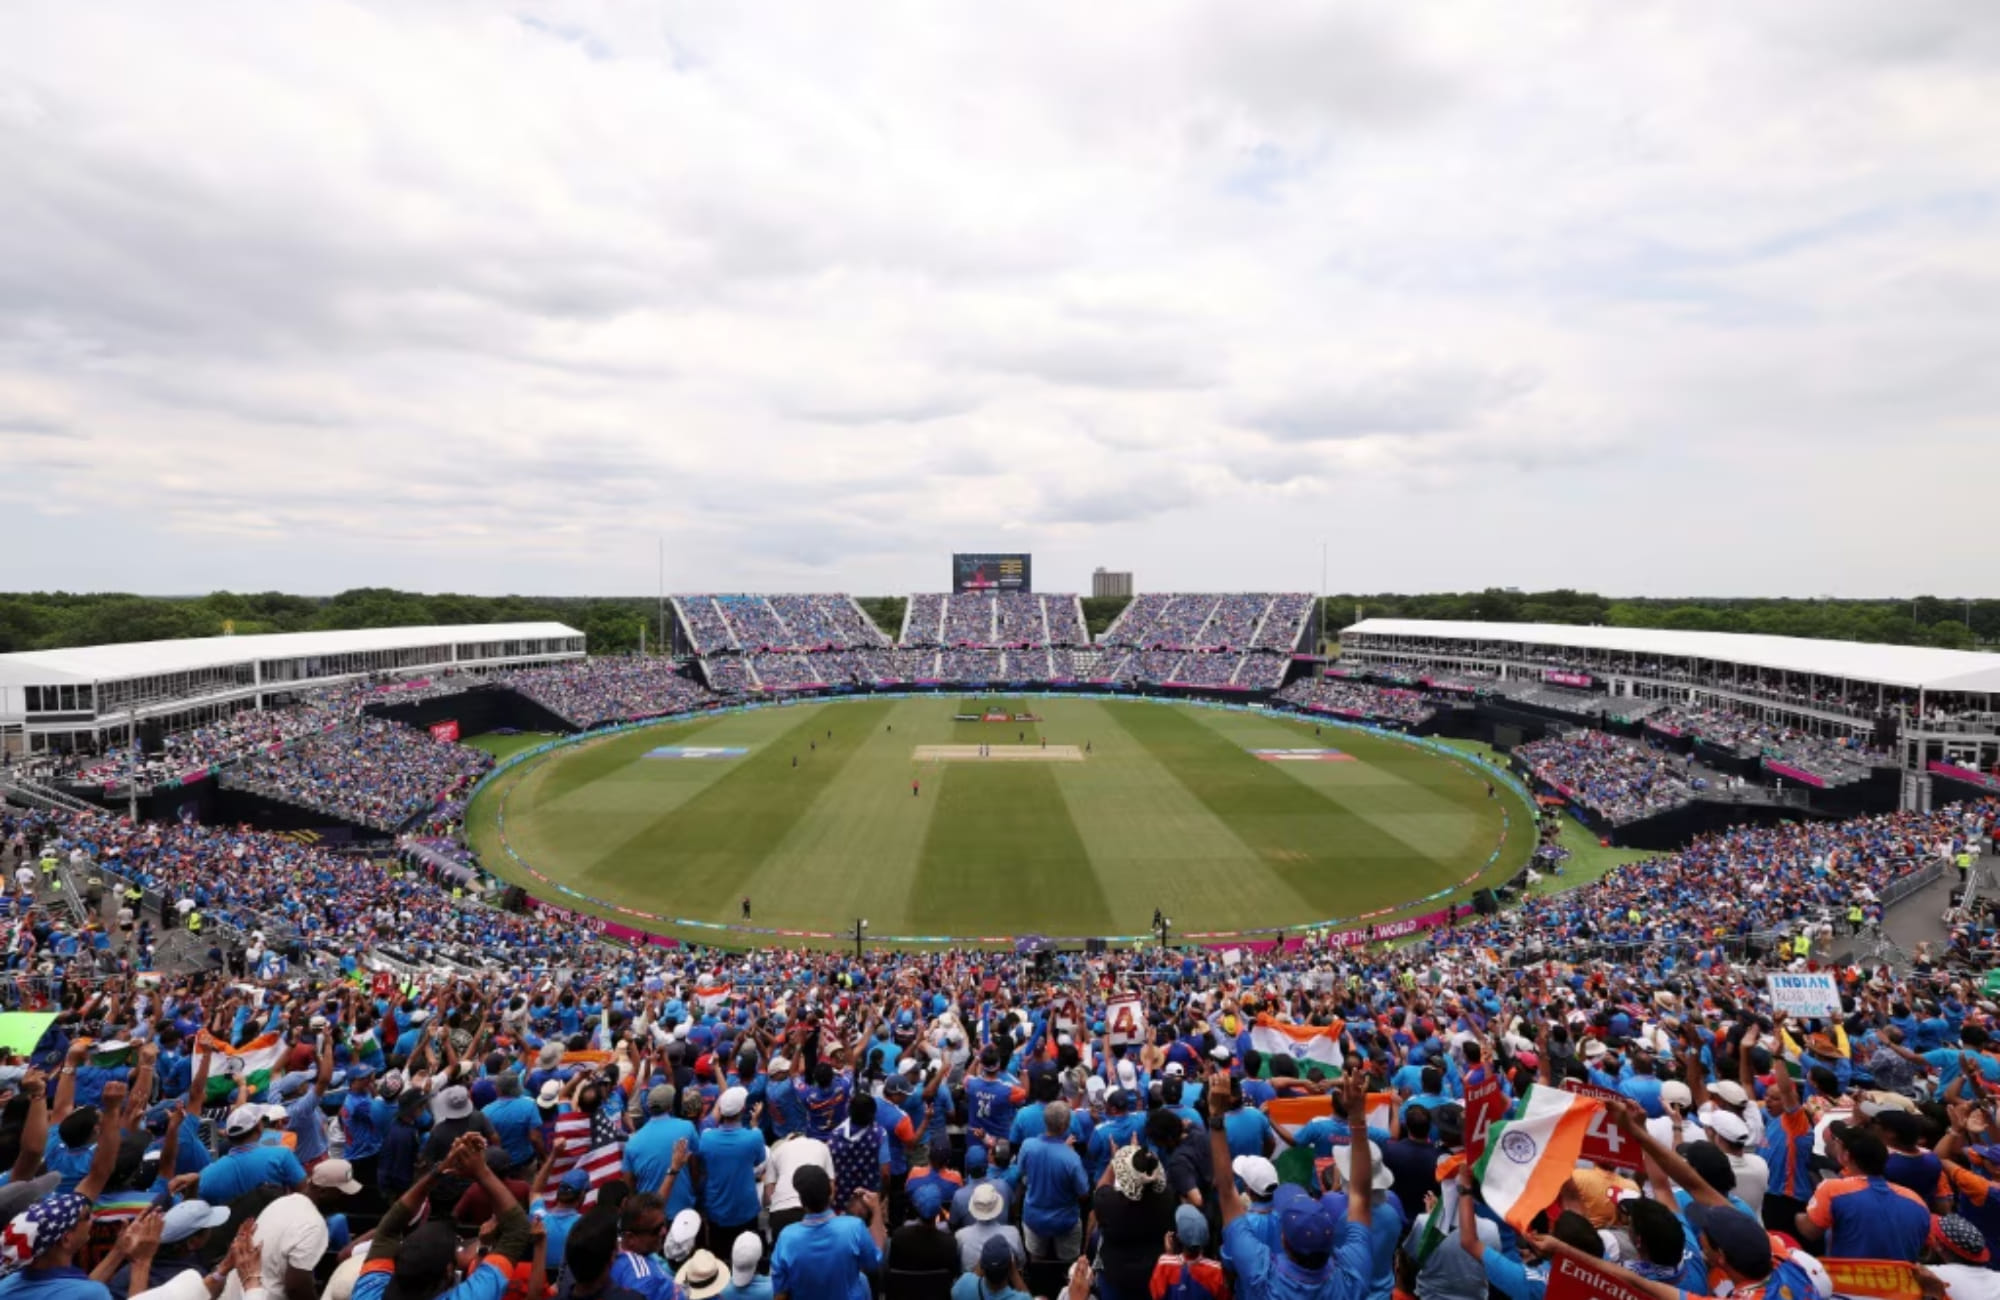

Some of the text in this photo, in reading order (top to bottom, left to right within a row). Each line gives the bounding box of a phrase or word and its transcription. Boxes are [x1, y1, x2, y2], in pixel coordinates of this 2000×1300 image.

[1332, 933, 1350, 946] OF
[1379, 920, 1416, 937] WORLD
[1773, 975, 1829, 989] INDIAN
[1112, 1005, 1137, 1039] 4
[1586, 1107, 1626, 1153] 4
